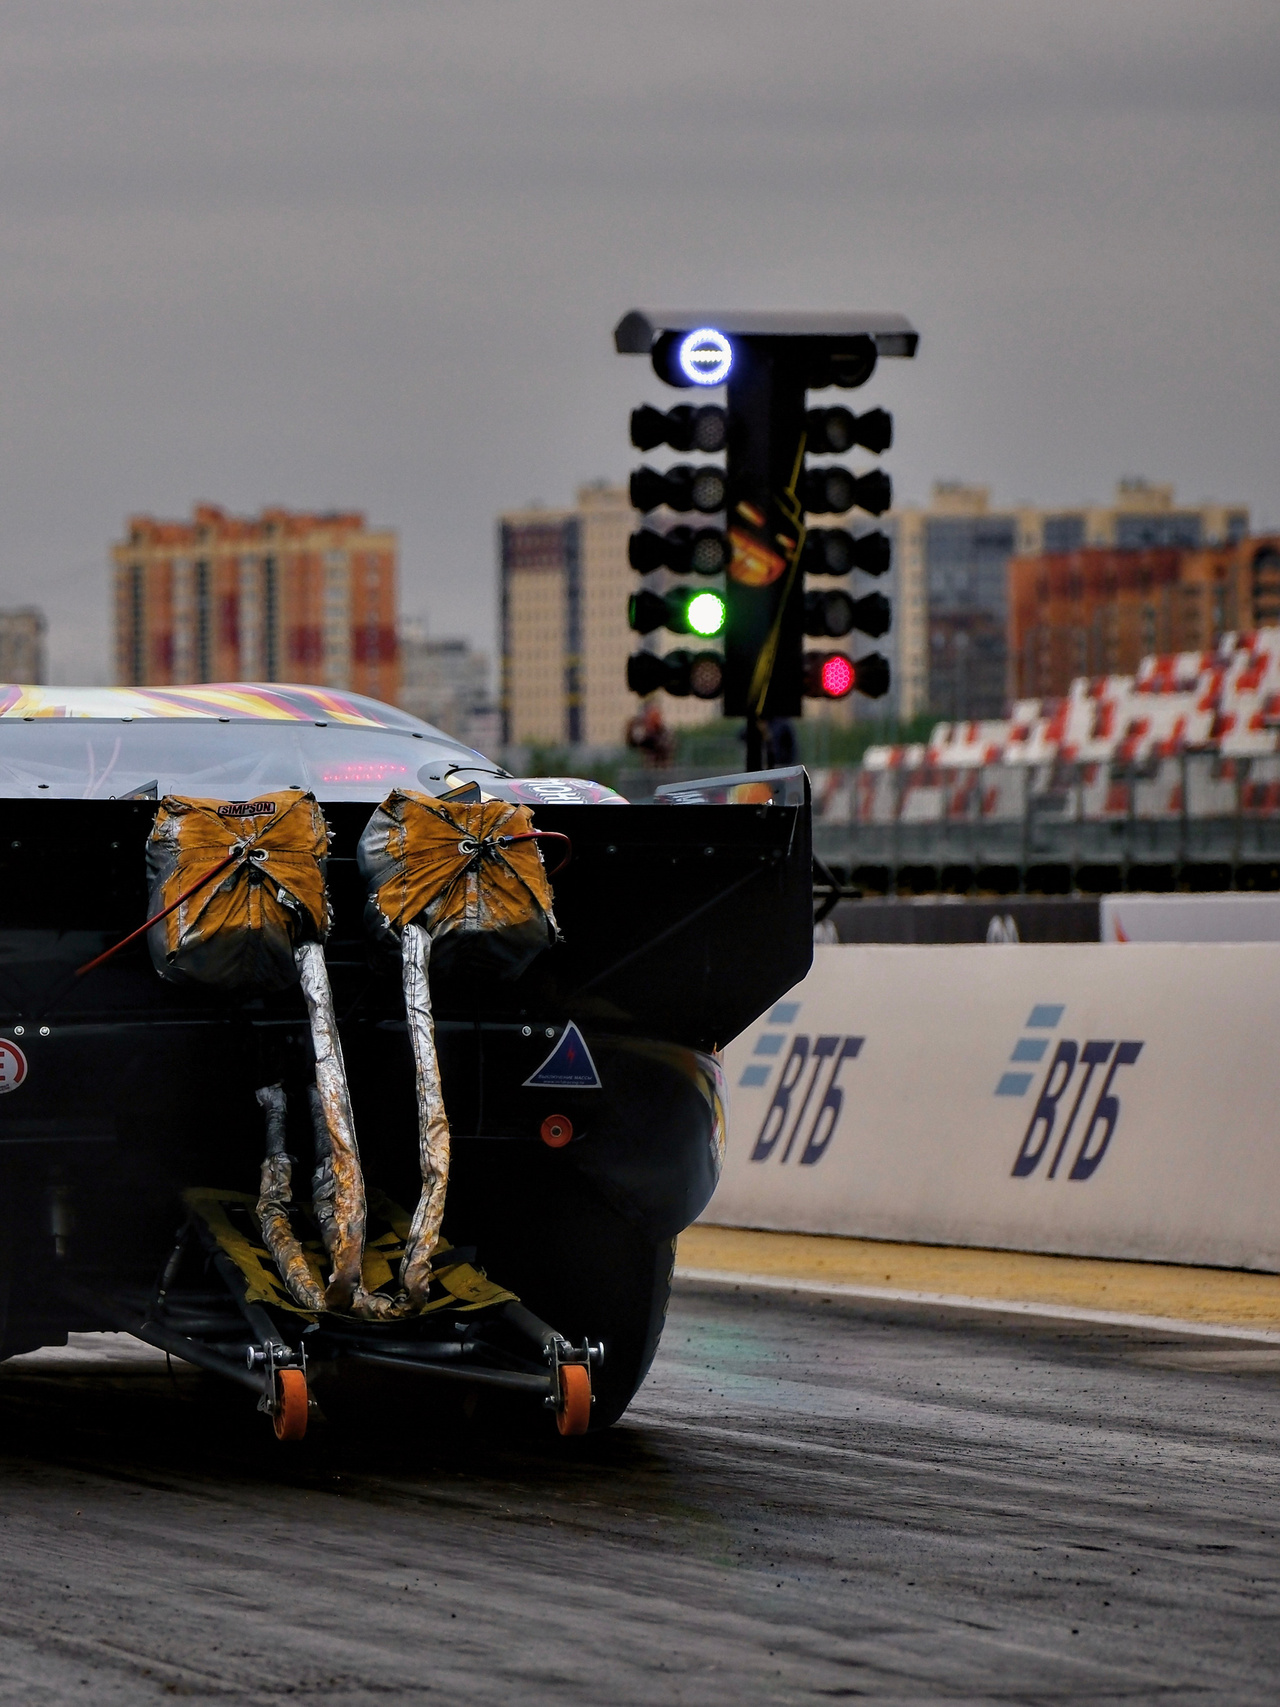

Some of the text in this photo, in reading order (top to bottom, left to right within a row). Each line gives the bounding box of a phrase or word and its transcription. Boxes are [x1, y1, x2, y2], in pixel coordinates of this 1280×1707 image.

[221, 802, 272, 815] SIMPSON
[750, 1034, 867, 1166] ВТБ
[1010, 1038, 1145, 1181] ВТБ
